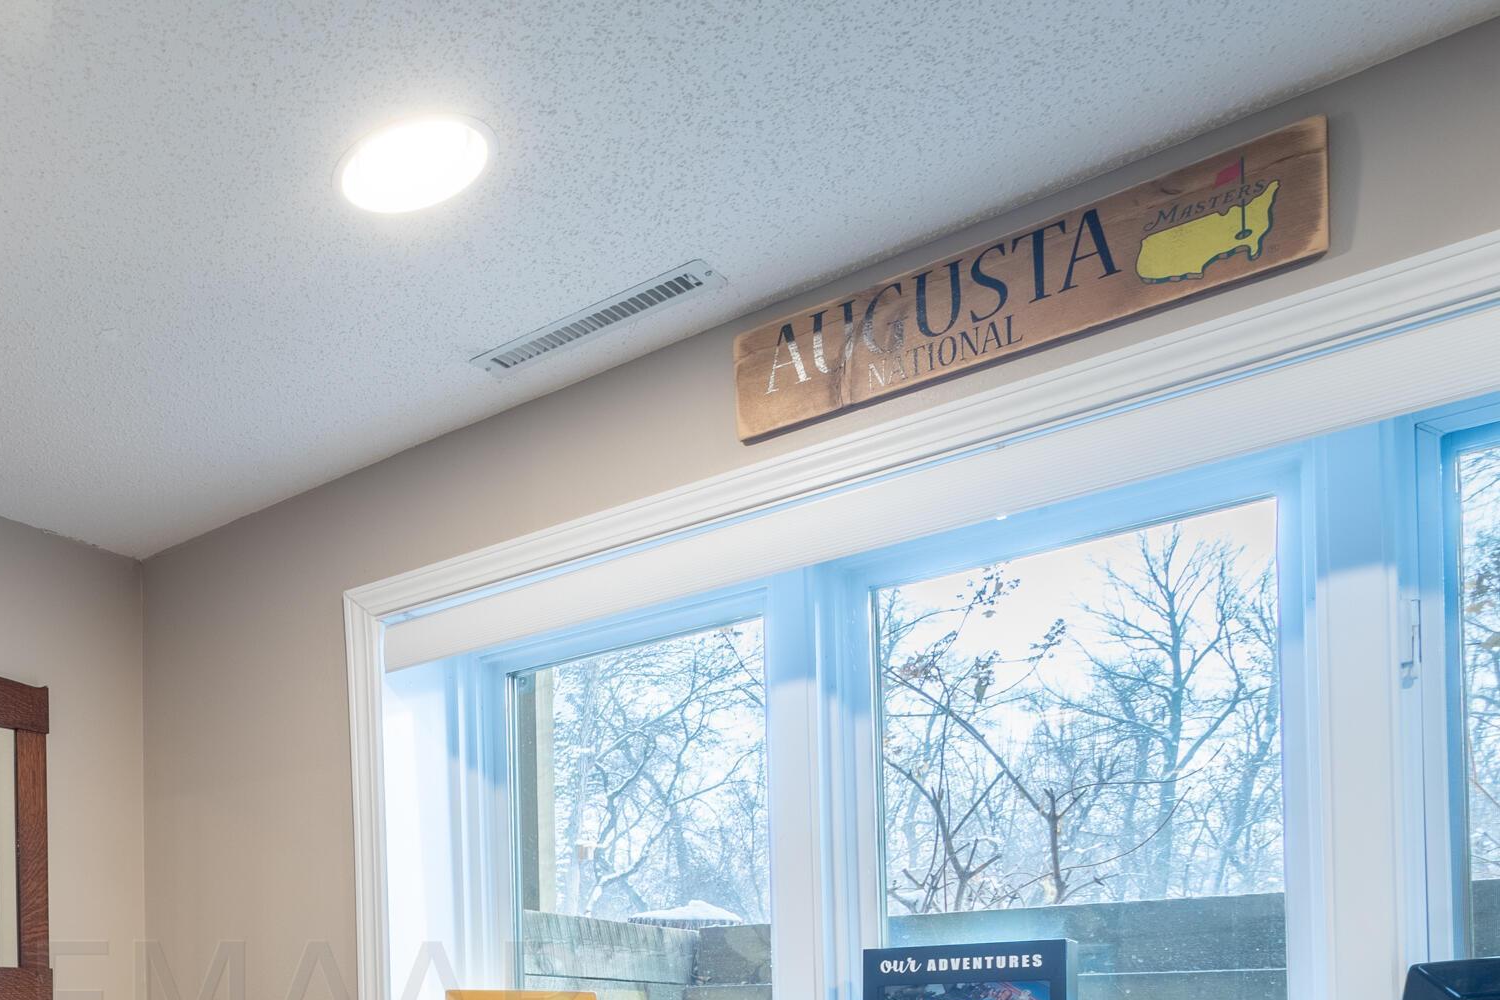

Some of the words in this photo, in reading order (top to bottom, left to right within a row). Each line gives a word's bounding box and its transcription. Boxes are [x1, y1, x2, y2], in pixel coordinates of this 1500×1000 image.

[764, 208, 1121, 394] AUGUSTA
[866, 313, 1024, 392] NATIONAL
[927, 953, 1043, 972] ADVENTURES
